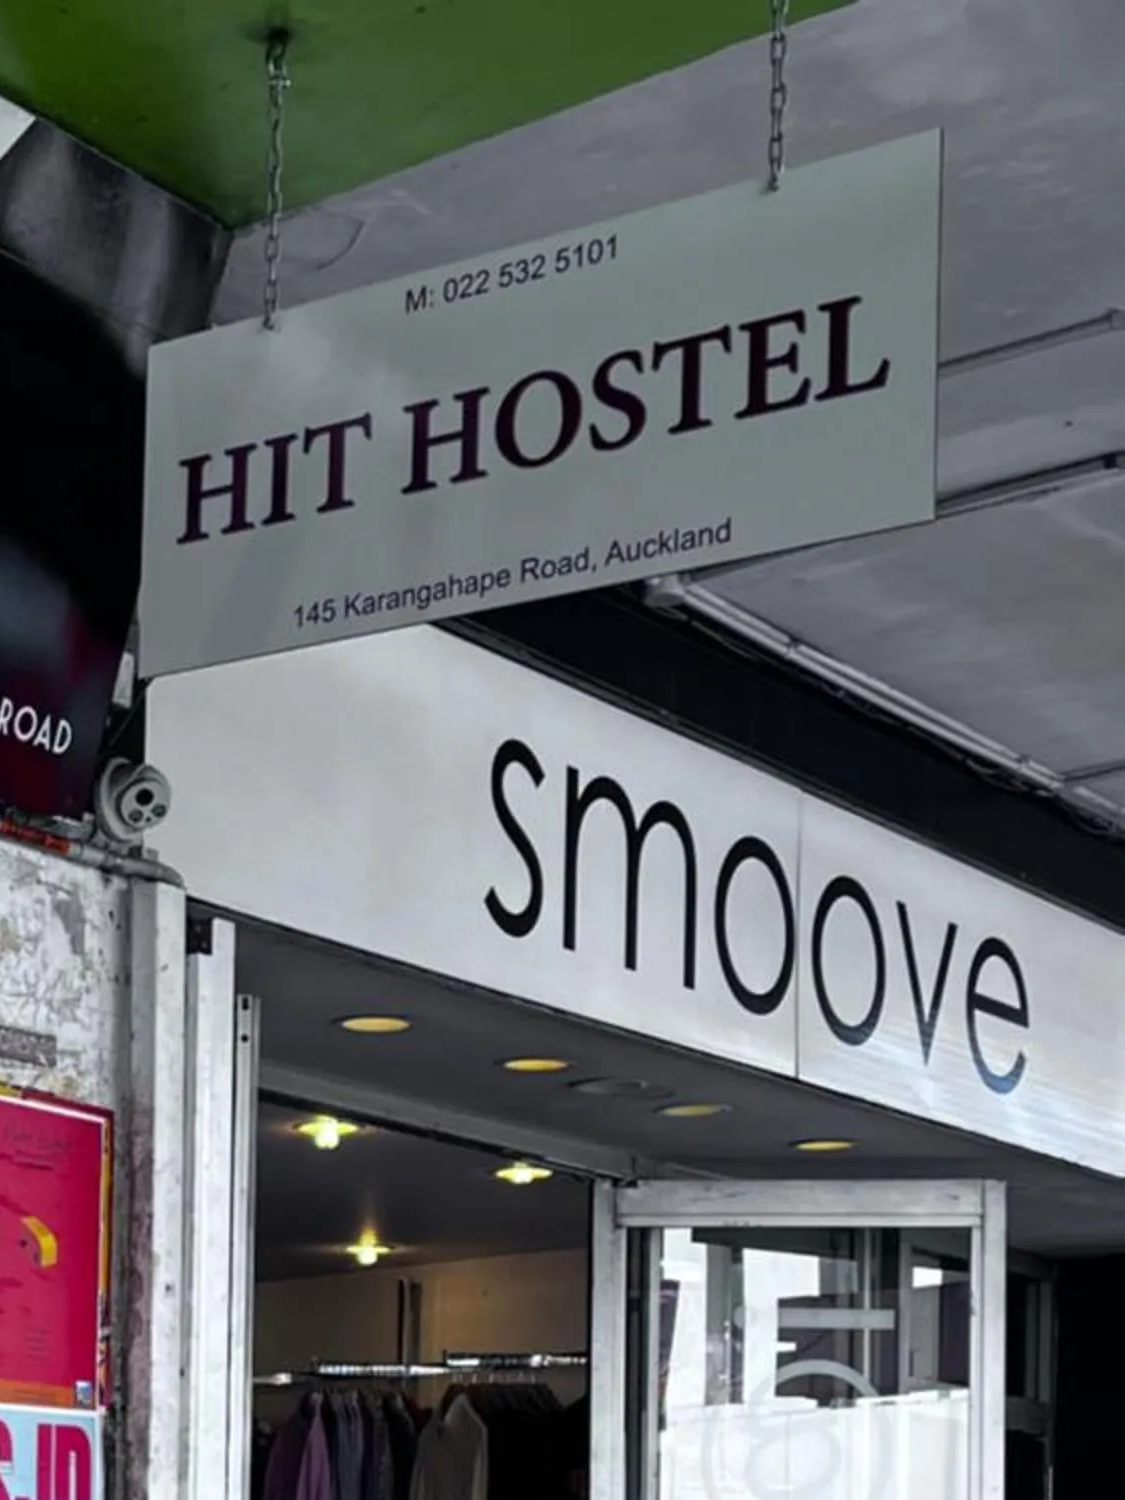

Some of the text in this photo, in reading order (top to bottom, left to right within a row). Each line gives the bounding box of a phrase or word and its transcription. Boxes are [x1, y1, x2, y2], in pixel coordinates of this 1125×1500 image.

[404, 235, 619, 314] M: 022 532 5101
[176, 296, 891, 544] HIT HOSTEL
[292, 517, 733, 629] 145 Karangahape Road, Auckland
[484, 738, 1030, 1095] smoove
